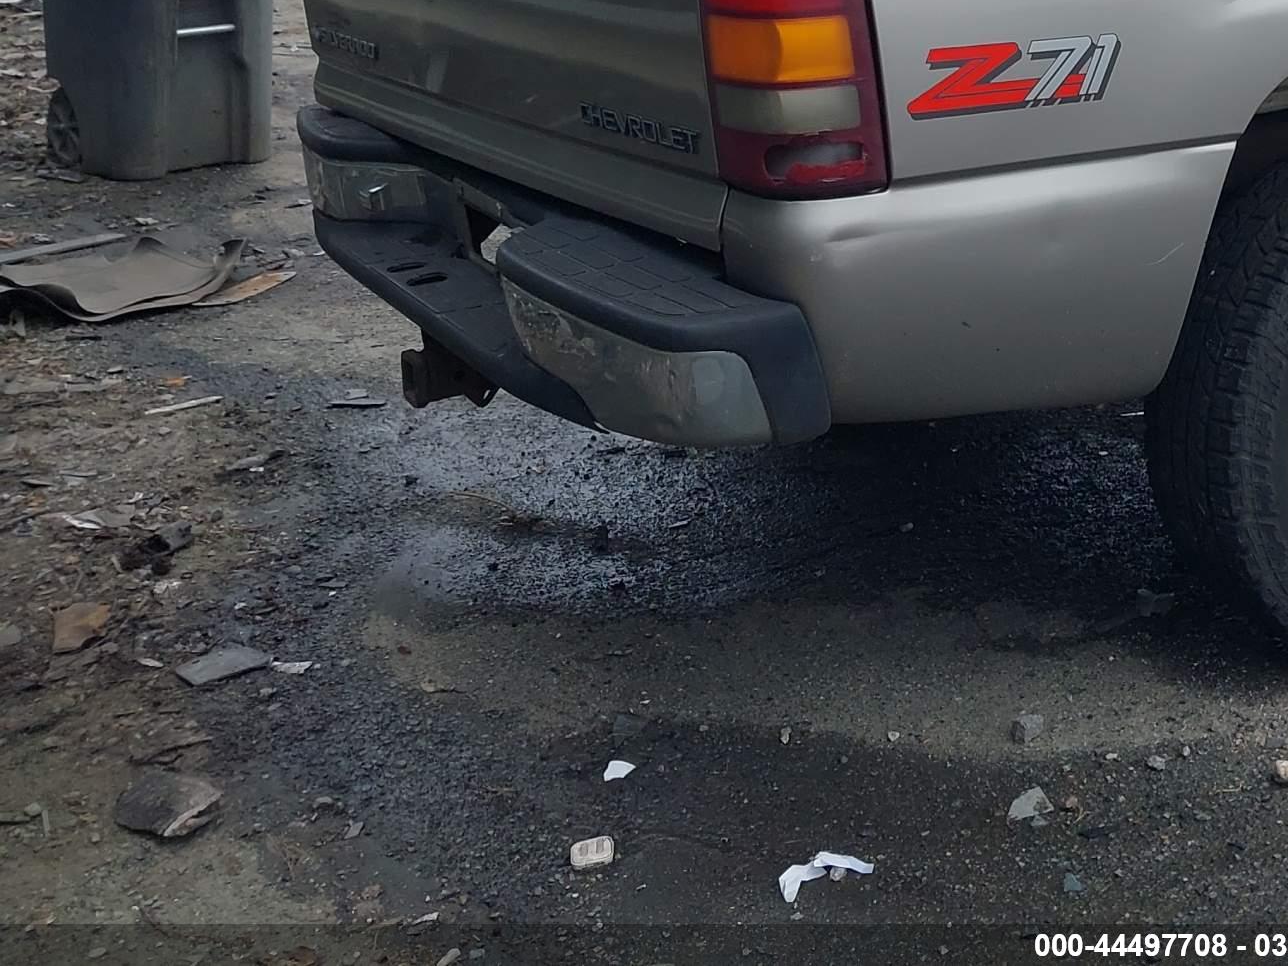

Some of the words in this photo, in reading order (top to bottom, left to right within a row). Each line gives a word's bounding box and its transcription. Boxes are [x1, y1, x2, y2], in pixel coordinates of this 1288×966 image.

[320, 26, 378, 60] SILVERADO
[906, 32, 1122, 121] Z71
[579, 101, 699, 155] CHEVROLET
